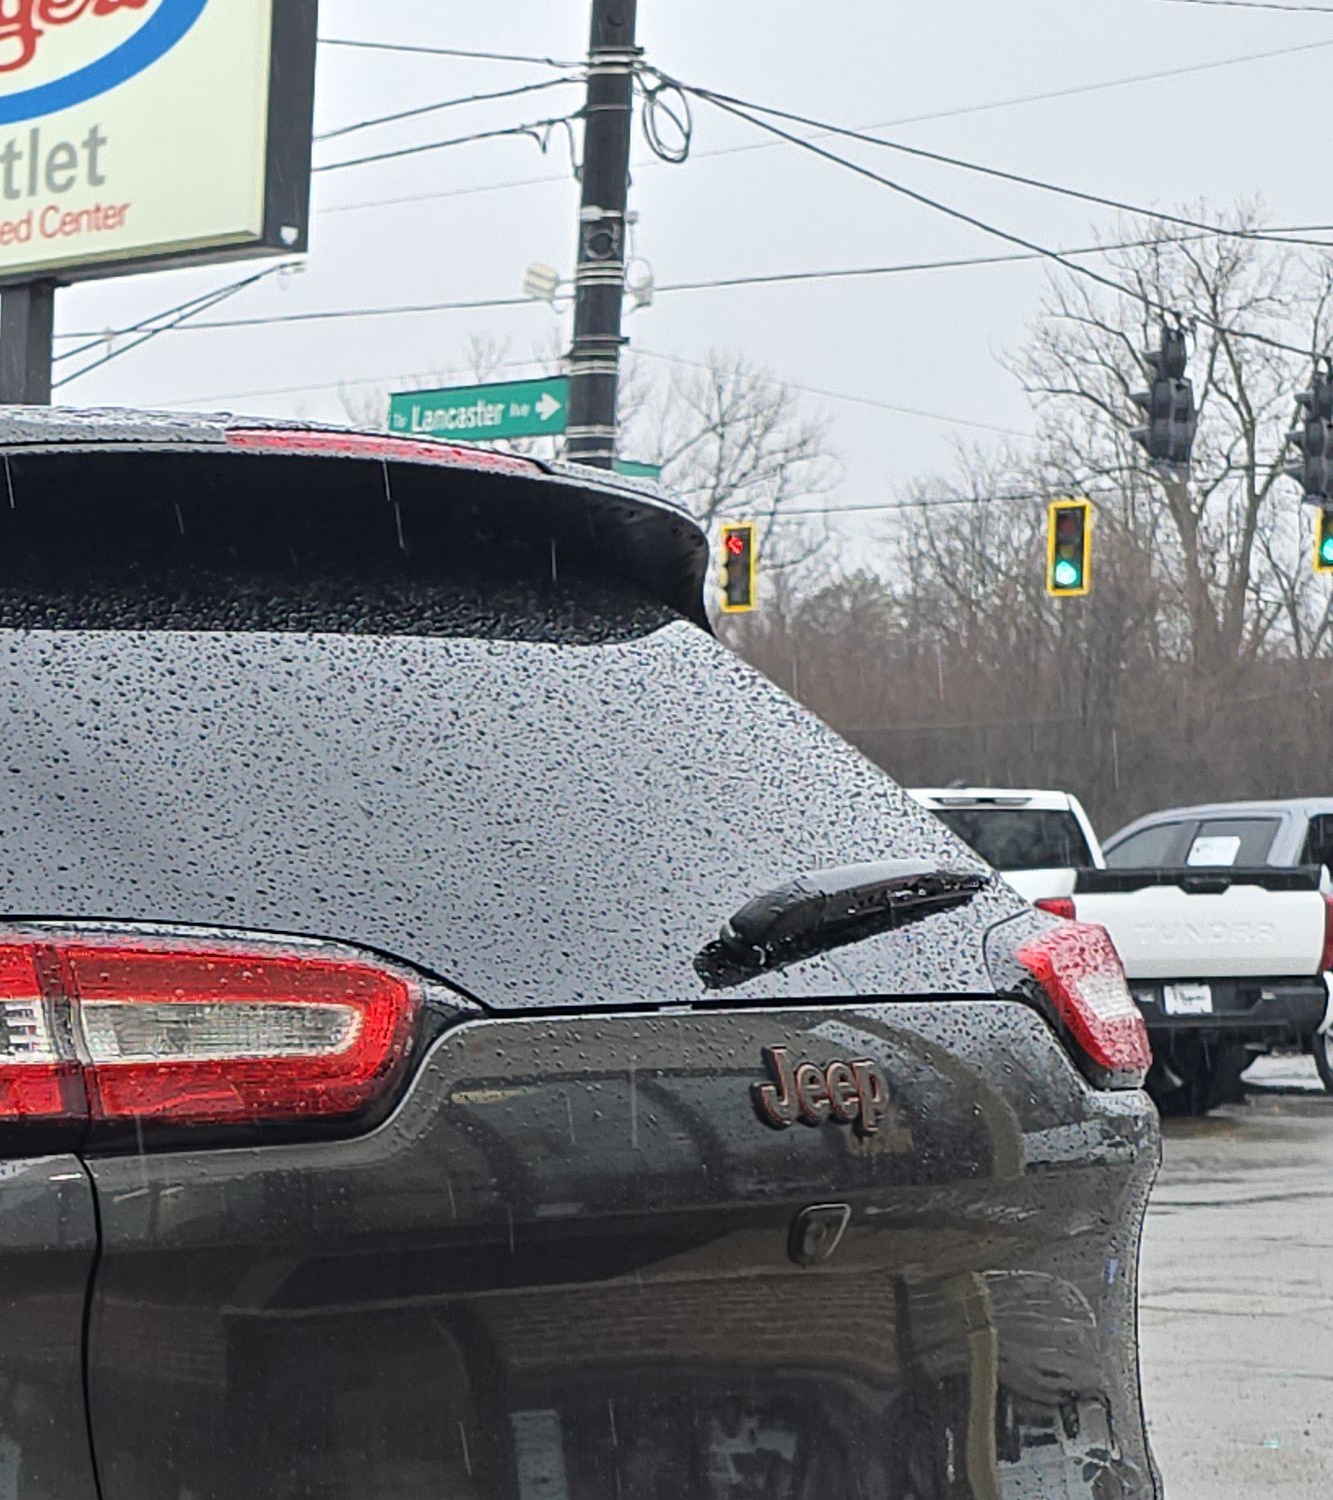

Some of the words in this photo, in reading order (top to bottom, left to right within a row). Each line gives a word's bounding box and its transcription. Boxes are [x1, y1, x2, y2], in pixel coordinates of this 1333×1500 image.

[39, 203, 131, 238] Center
[411, 399, 505, 432] Lancaster
[754, 1045, 890, 1134] Jeep
